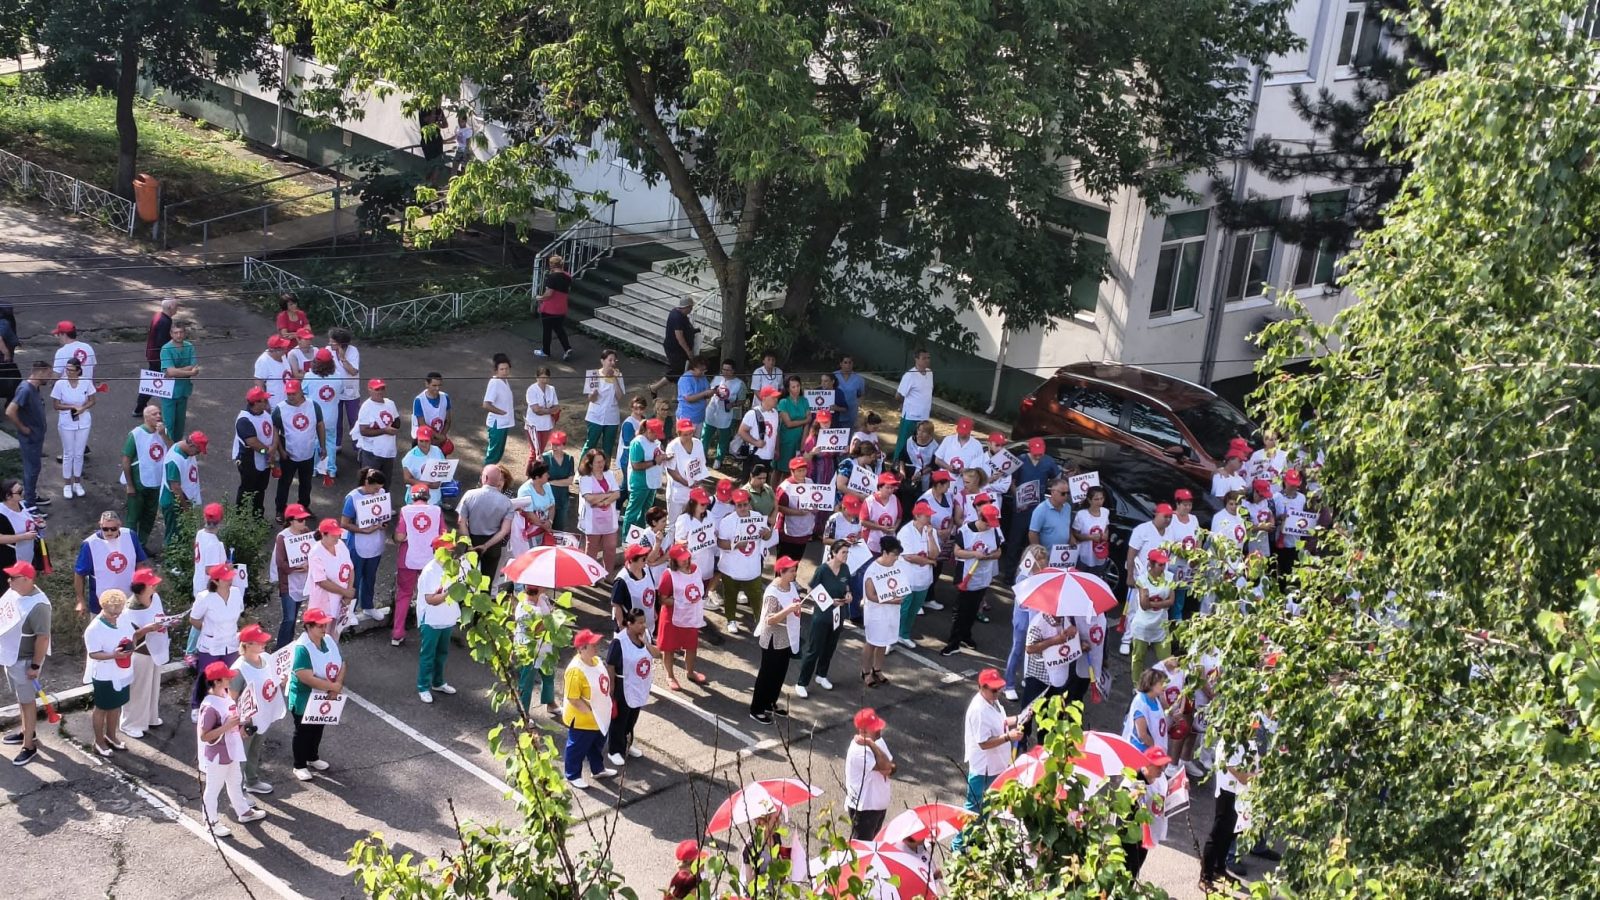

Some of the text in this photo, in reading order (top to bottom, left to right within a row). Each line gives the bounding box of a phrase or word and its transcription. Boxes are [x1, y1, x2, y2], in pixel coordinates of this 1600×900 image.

[141, 387, 172, 397] VRANCEA
[689, 461, 700, 471] STOP
[1072, 474, 1095, 482] SANITAS
[850, 483, 873, 494] VRANCE
[361, 495, 387, 506] SANITAS
[1073, 493, 1087, 501] VRAN
[360, 513, 390, 526] VRANCEA
[1291, 511, 1317, 519] SANITAS
[1285, 527, 1309, 535] VRANC
[289, 534, 313, 544] SANITA
[691, 540, 715, 552] VRANCEA
[290, 555, 308, 565] VRAN
[876, 569, 901, 580] SANITAS
[880, 588, 909, 600] VRANCEA
[276, 653, 291, 666] STOP
[1047, 650, 1080, 666] VRANCEA
[304, 715, 338, 723] VRANCEA
